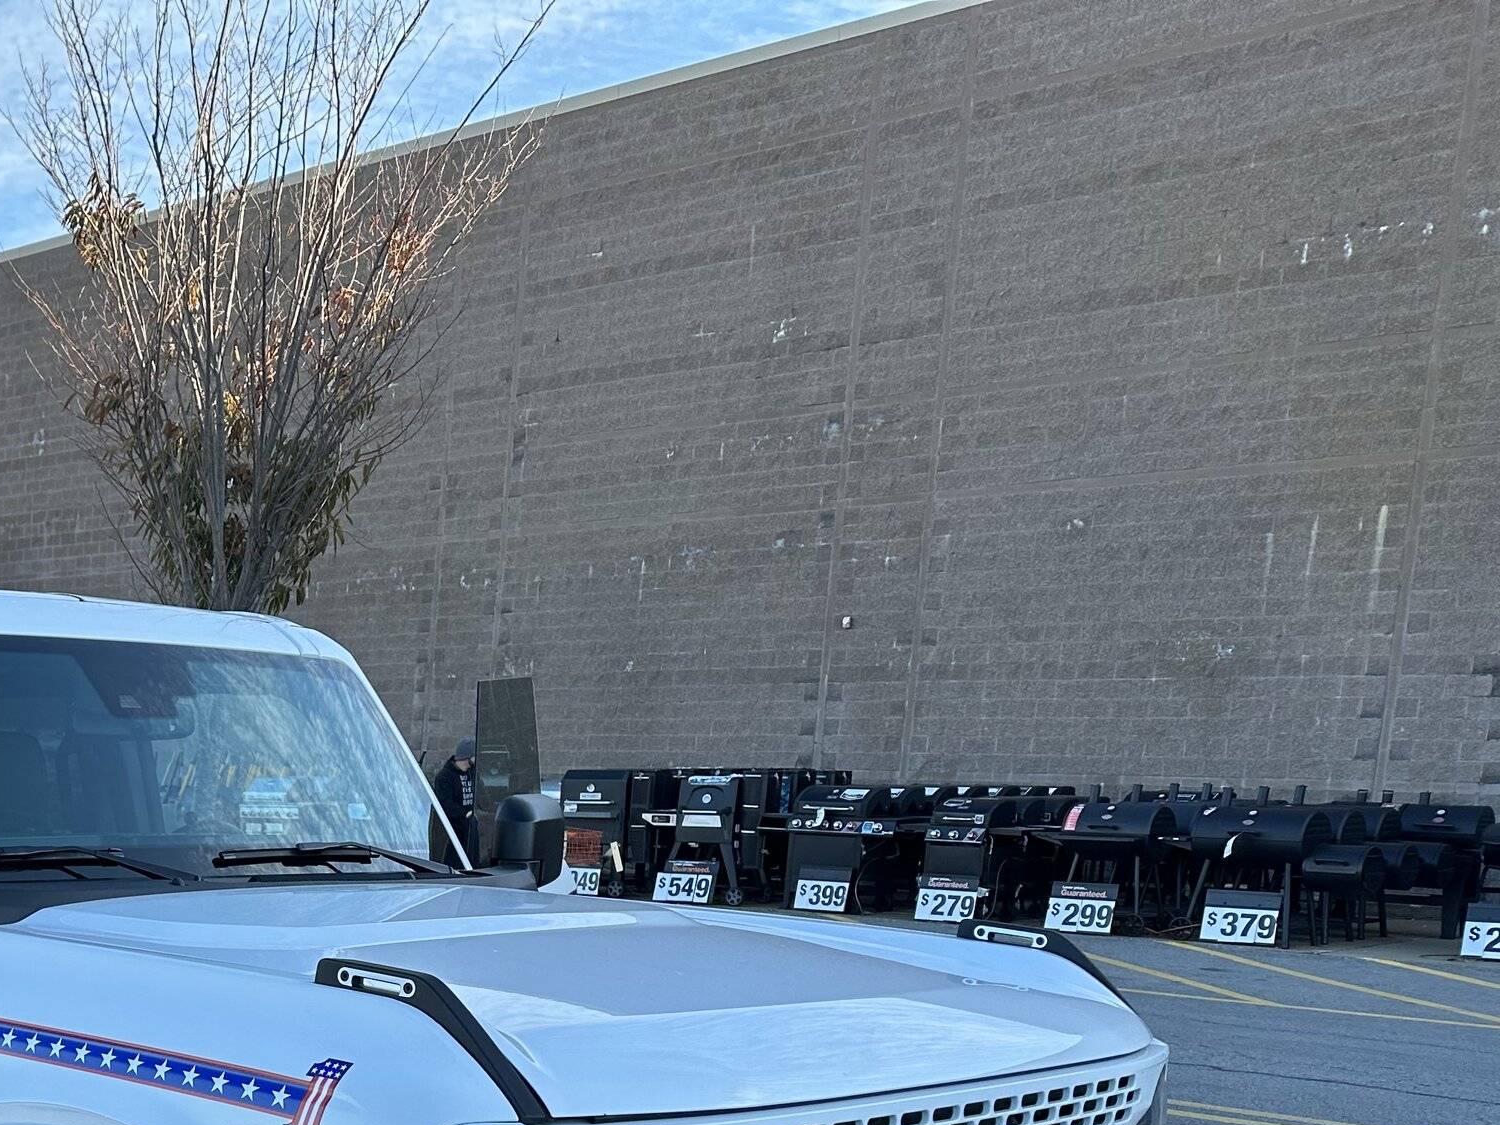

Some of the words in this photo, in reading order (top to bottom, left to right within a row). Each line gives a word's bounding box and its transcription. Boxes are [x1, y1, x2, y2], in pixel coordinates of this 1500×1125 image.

[658, 876, 710, 898] $549
[799, 883, 846, 907] $399
[920, 893, 975, 918] $279
[1051, 902, 1113, 929] $299
[1207, 911, 1276, 939] $379
